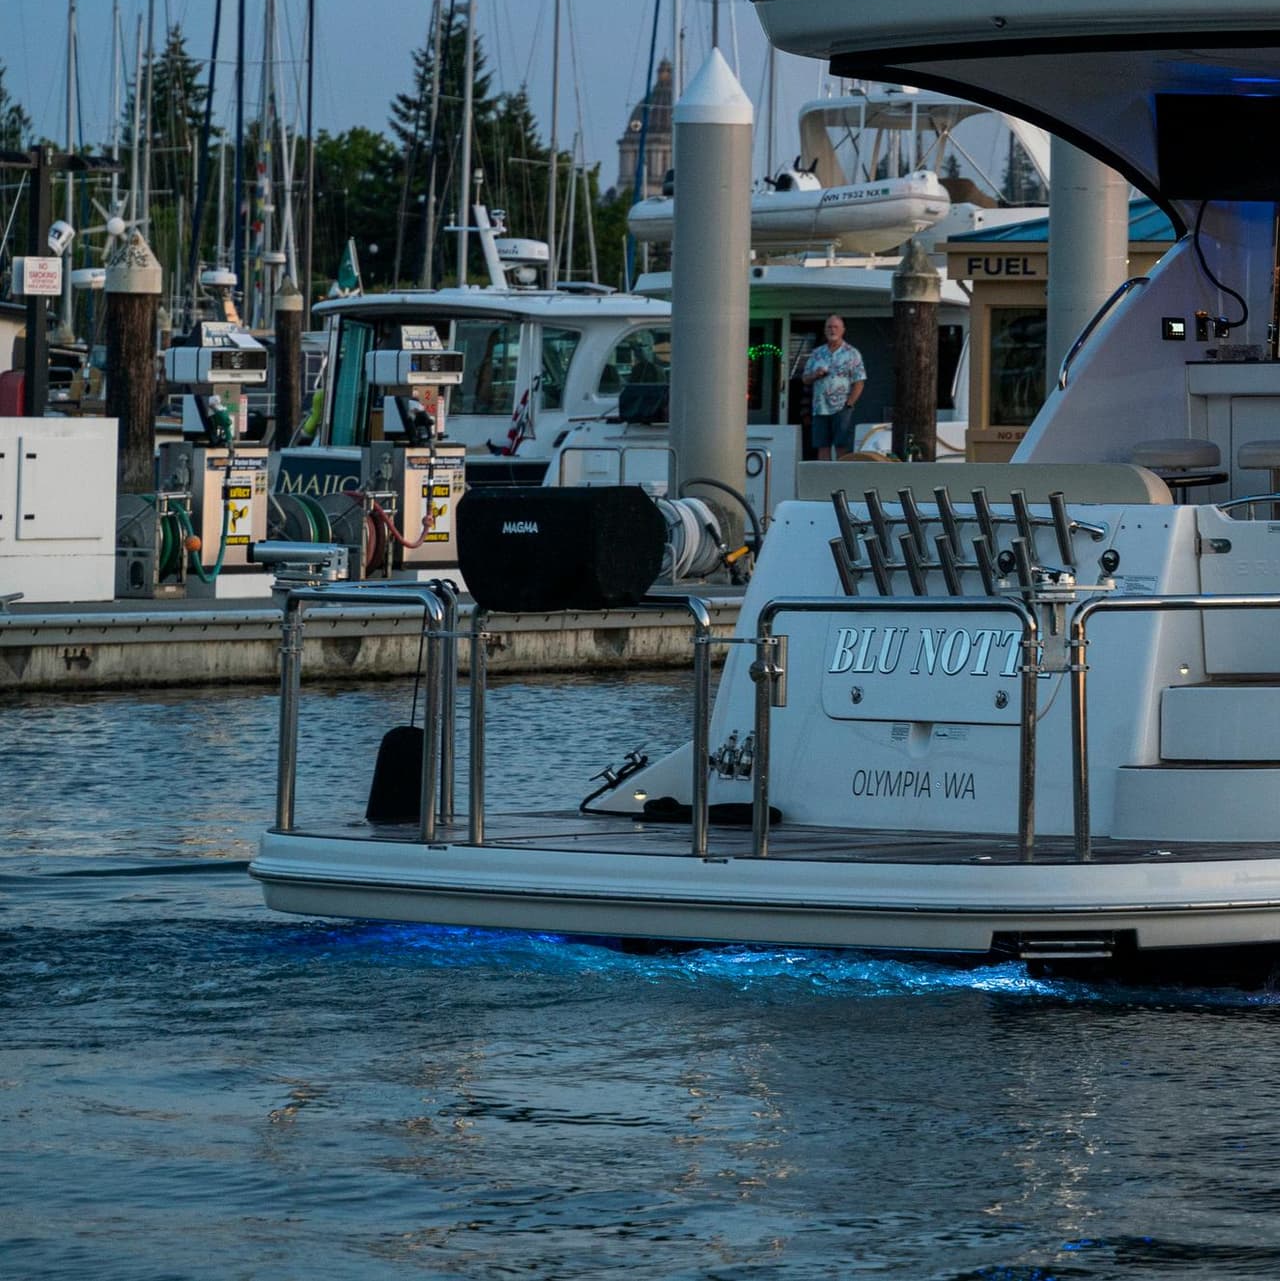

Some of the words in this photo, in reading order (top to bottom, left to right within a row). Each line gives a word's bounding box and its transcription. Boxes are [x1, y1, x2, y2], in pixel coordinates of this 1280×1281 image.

[967, 257, 1037, 276] FUEL
[502, 521, 539, 534] MAGMA
[828, 627, 909, 675] BLU
[852, 769, 932, 798] OLYMPIA
[944, 771, 976, 800] WA
